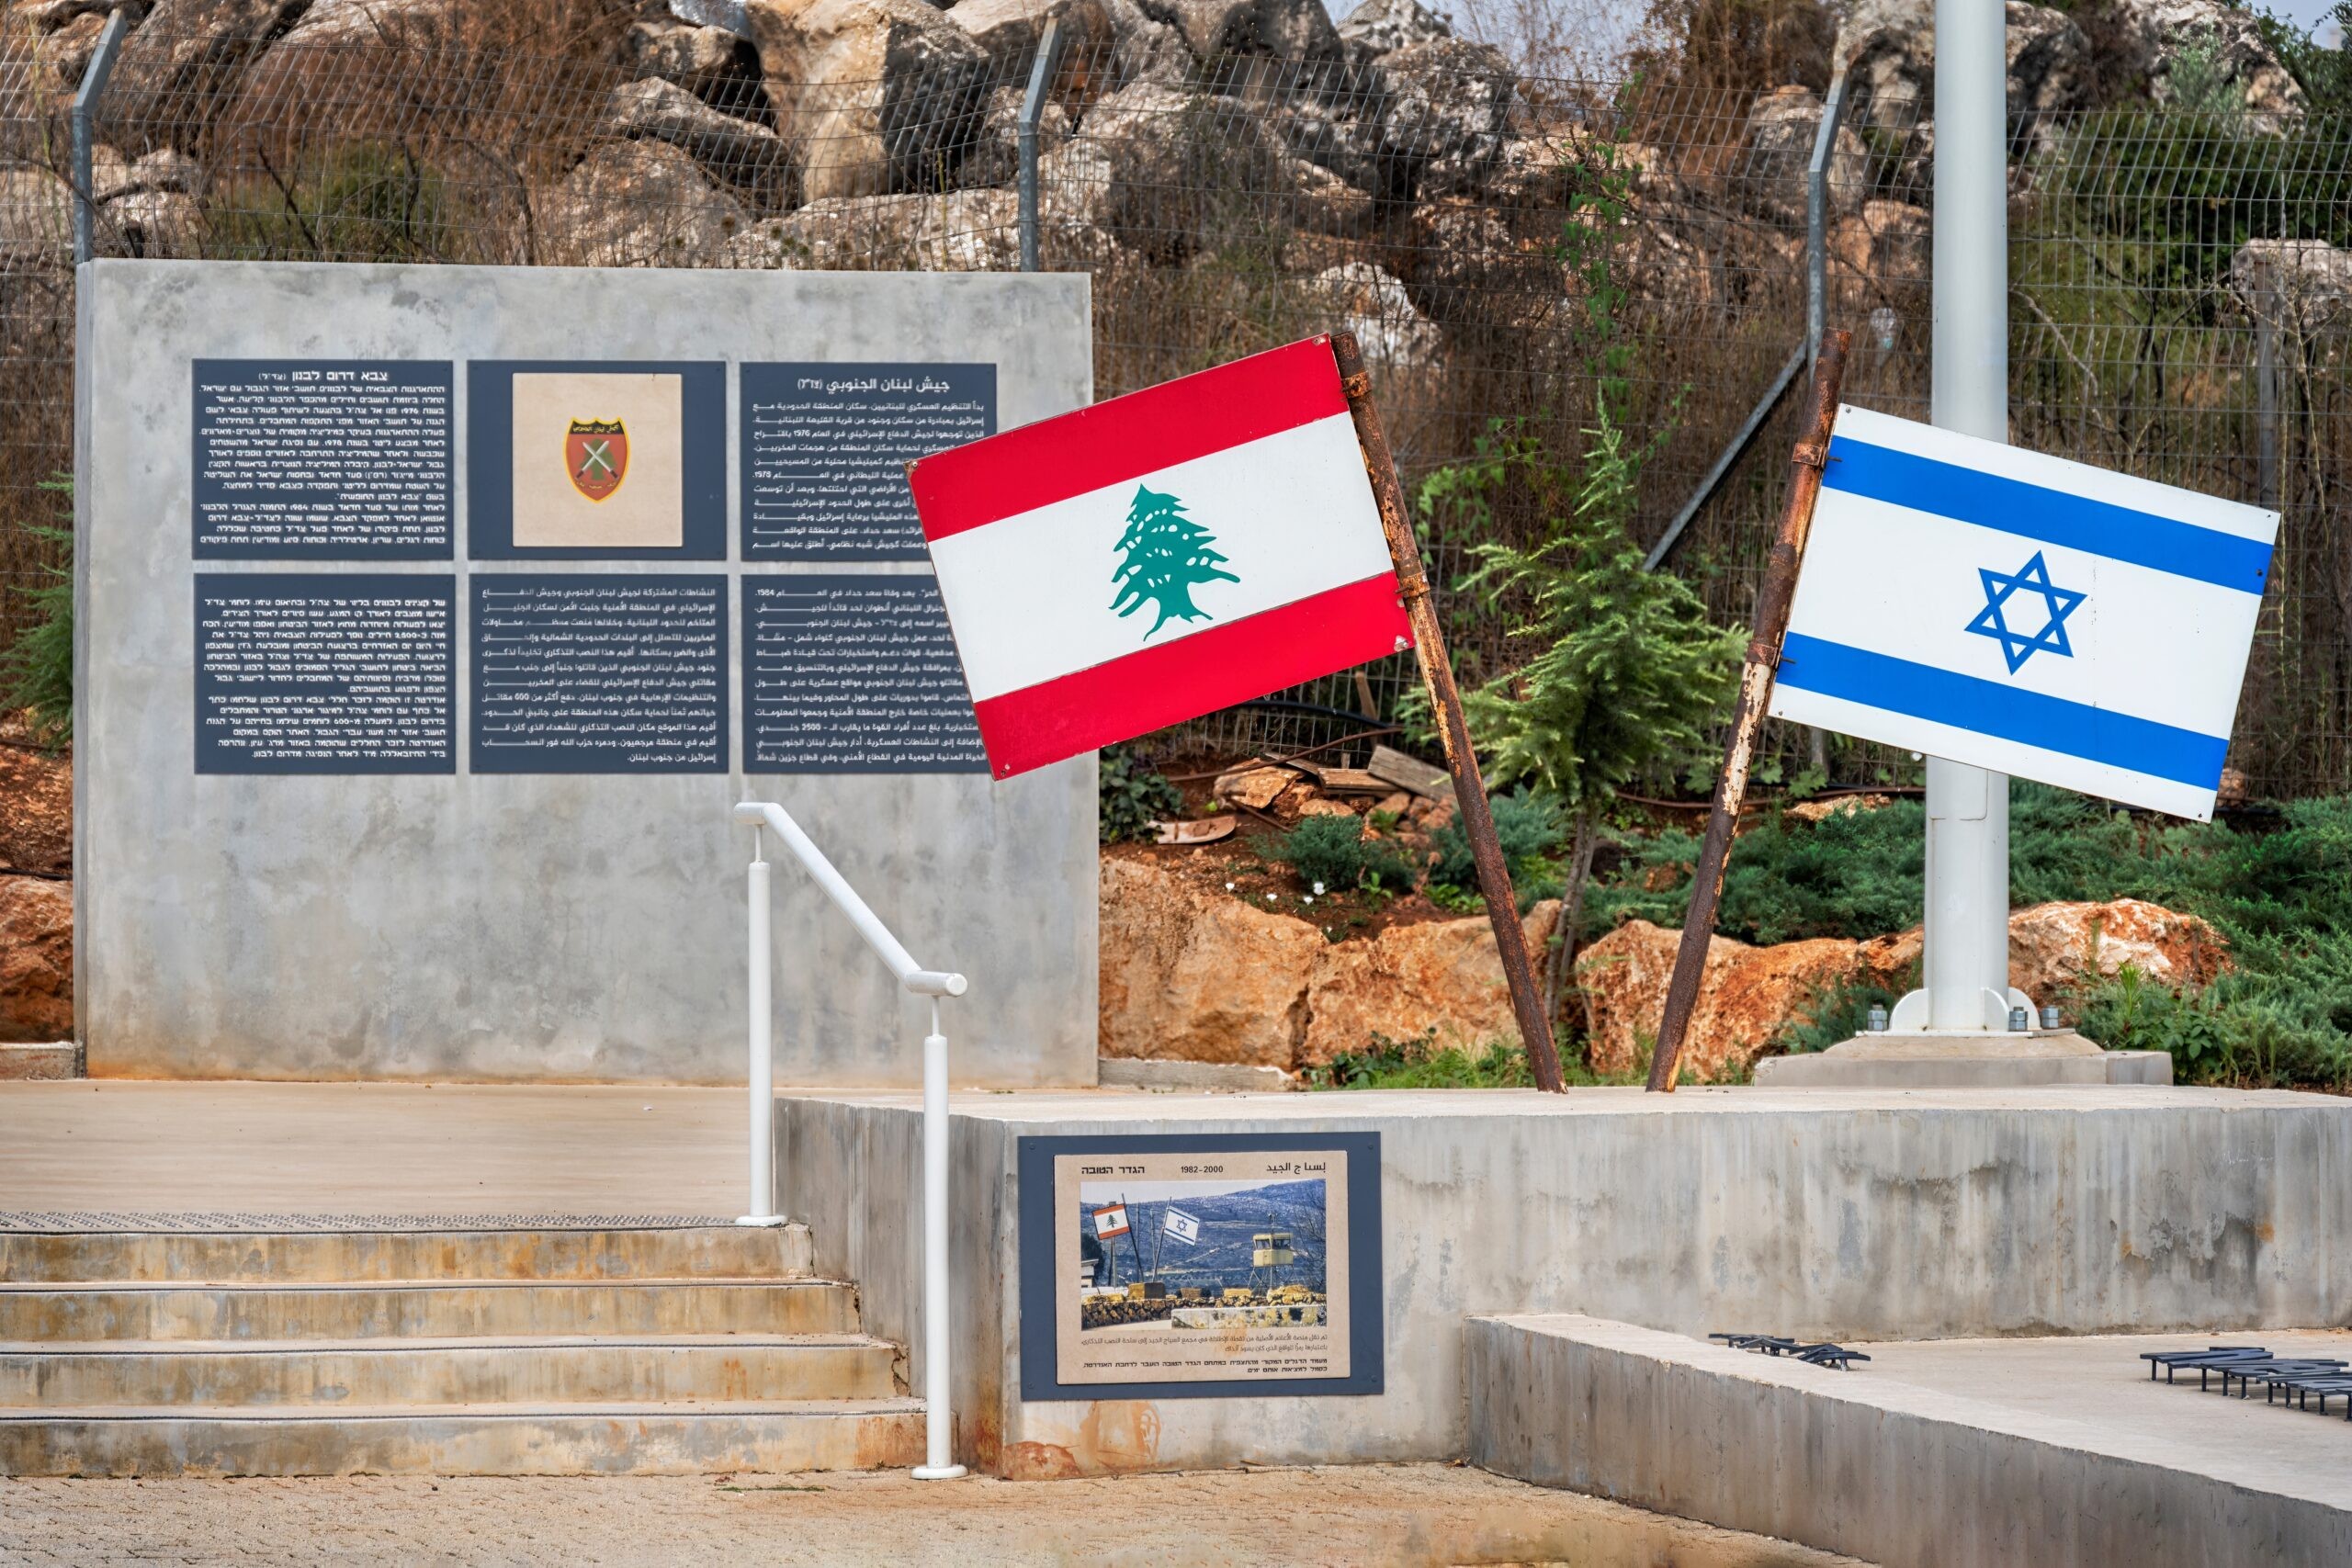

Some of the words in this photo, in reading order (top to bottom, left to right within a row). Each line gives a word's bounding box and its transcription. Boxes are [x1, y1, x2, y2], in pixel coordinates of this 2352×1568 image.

[292, 370, 322, 382] לבנון
[326, 371, 356, 381] דרום
[360, 371, 389, 381] צבא
[827, 378, 876, 394] الجنوبي
[880, 378, 912, 392] لبنان
[916, 376, 950, 393] جيش
[1181, 1165, 1224, 1174] 1982-2000
[1266, 1162, 1290, 1174] الجيد
